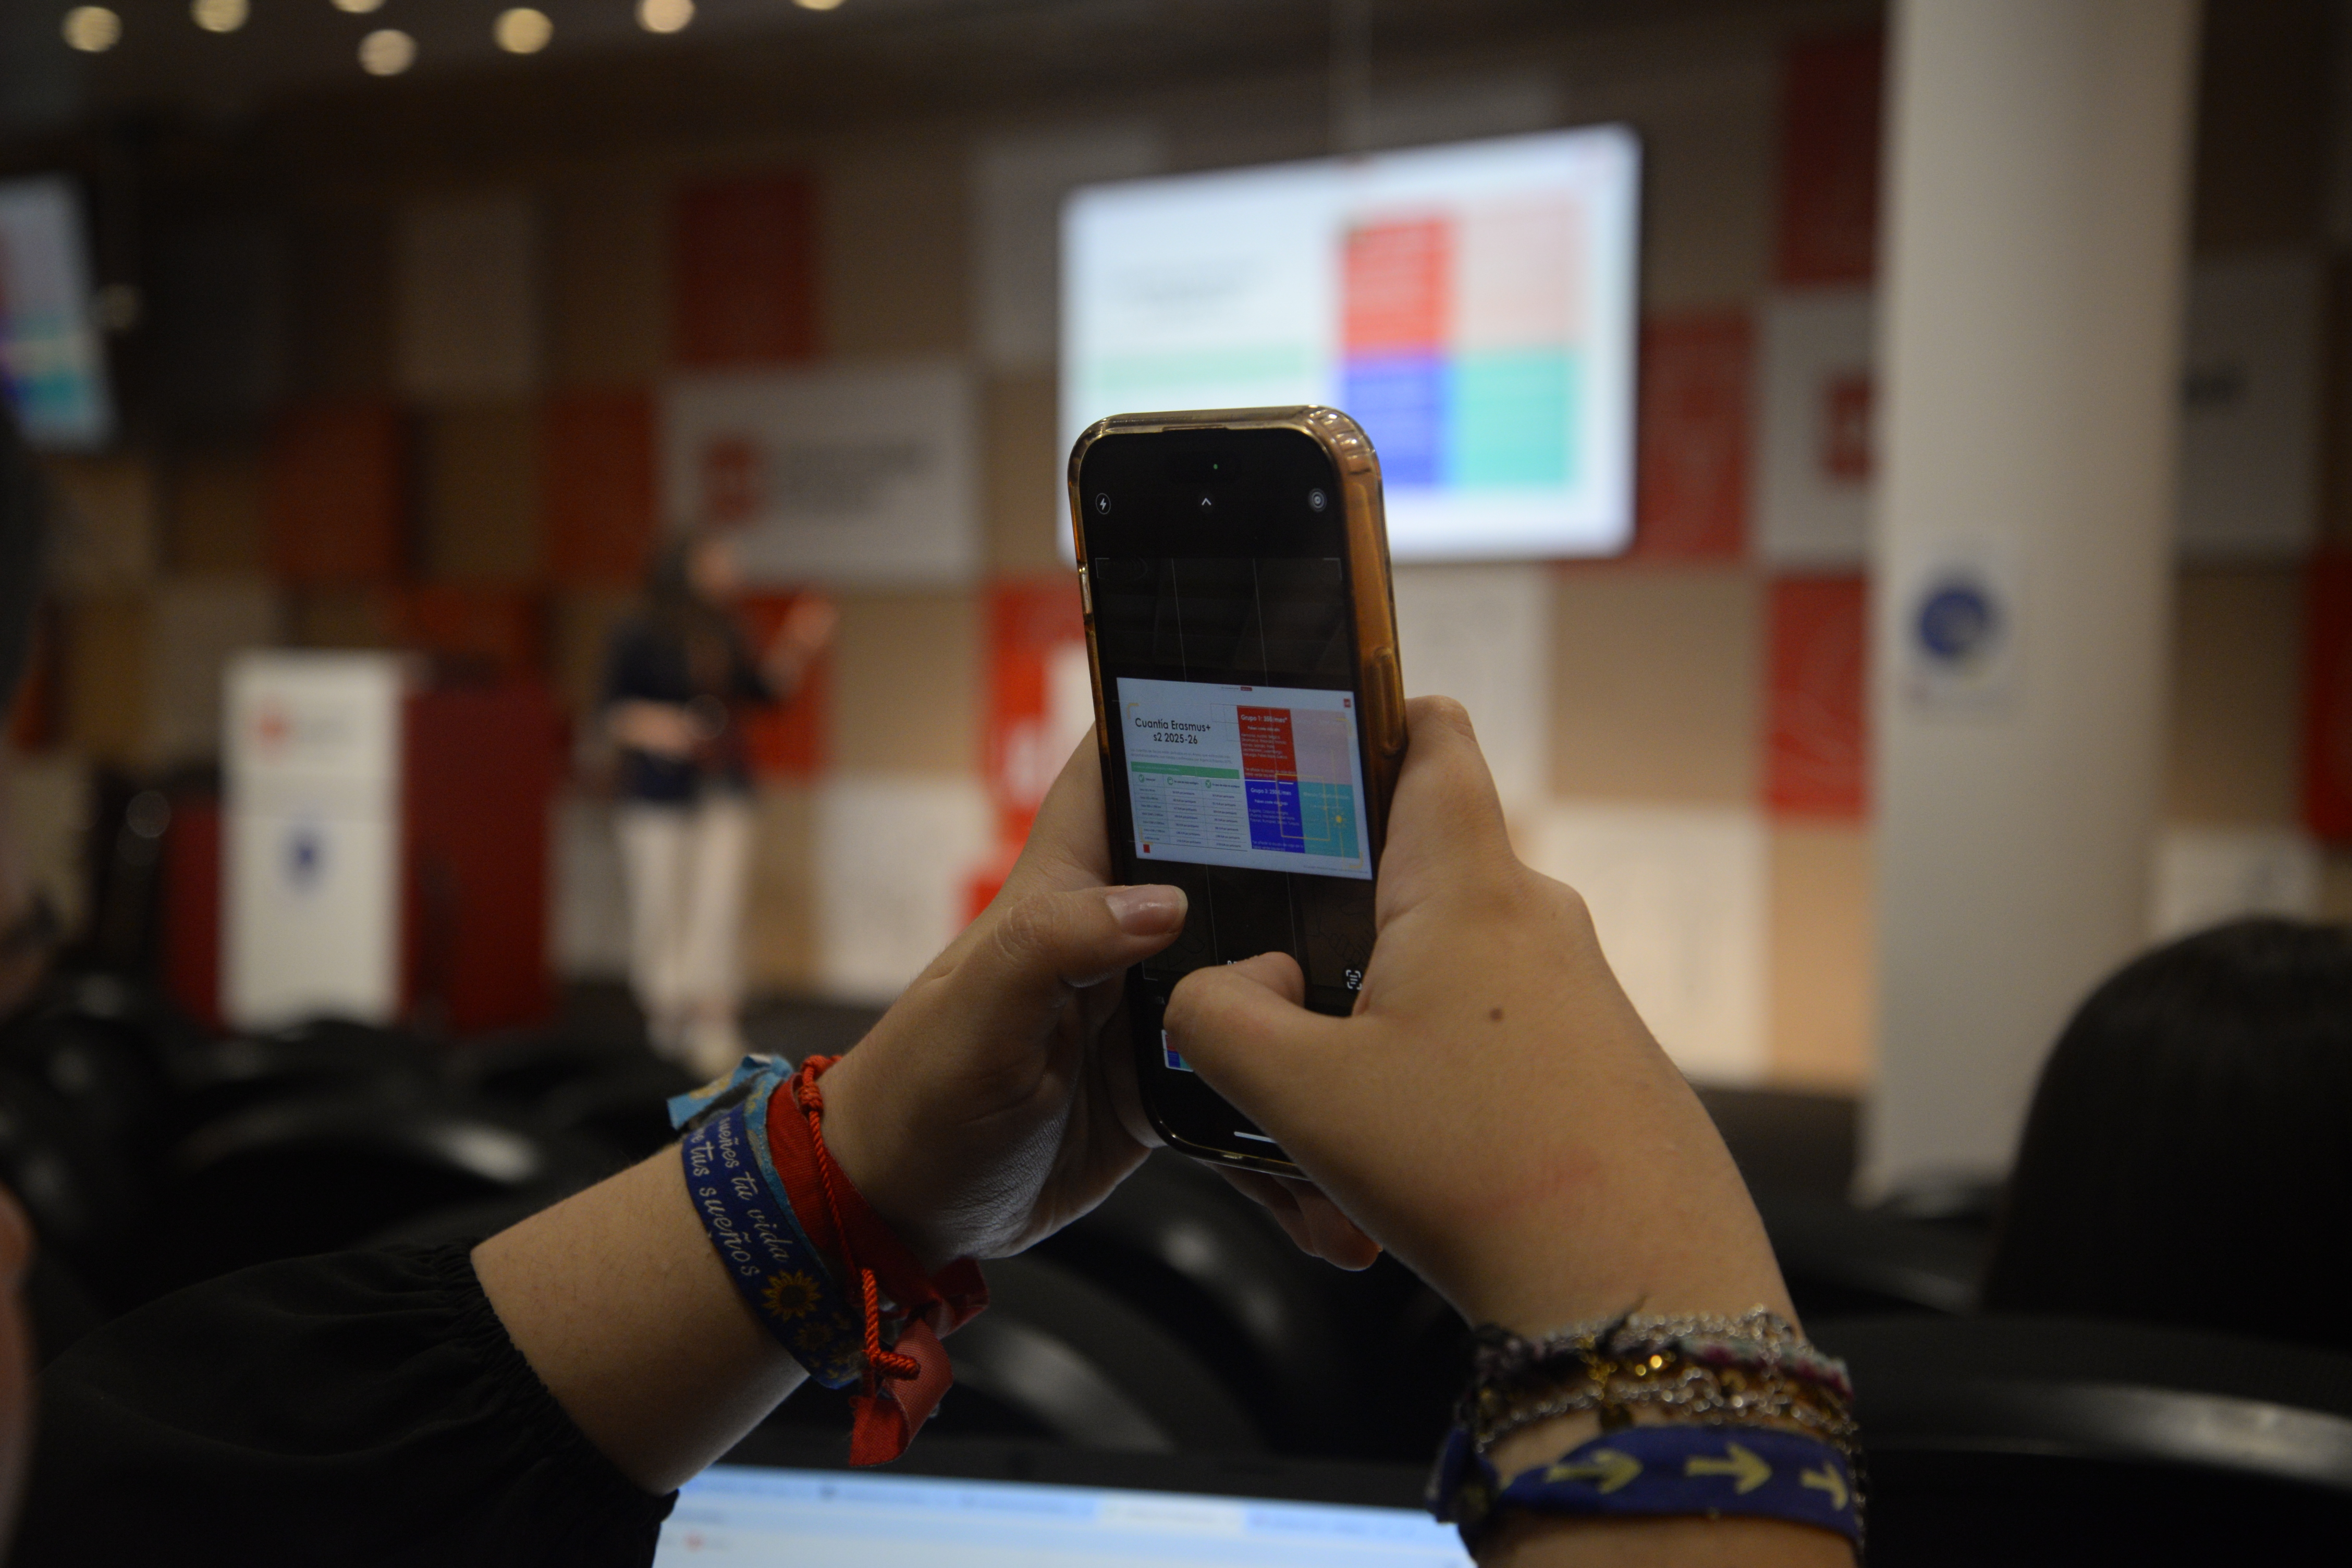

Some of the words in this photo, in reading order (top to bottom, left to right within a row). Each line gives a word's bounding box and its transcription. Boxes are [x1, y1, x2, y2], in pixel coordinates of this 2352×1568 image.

[1135, 717, 1169, 729] Cuantía
[1171, 720, 1211, 732] Erasmus+
[1153, 732, 1162, 742] s2
[1165, 732, 1198, 744] 2025-26
[690, 1141, 714, 1177] tus
[699, 1187, 761, 1276] sueños
[731, 1171, 759, 1200] tu
[746, 1209, 793, 1263] vida
